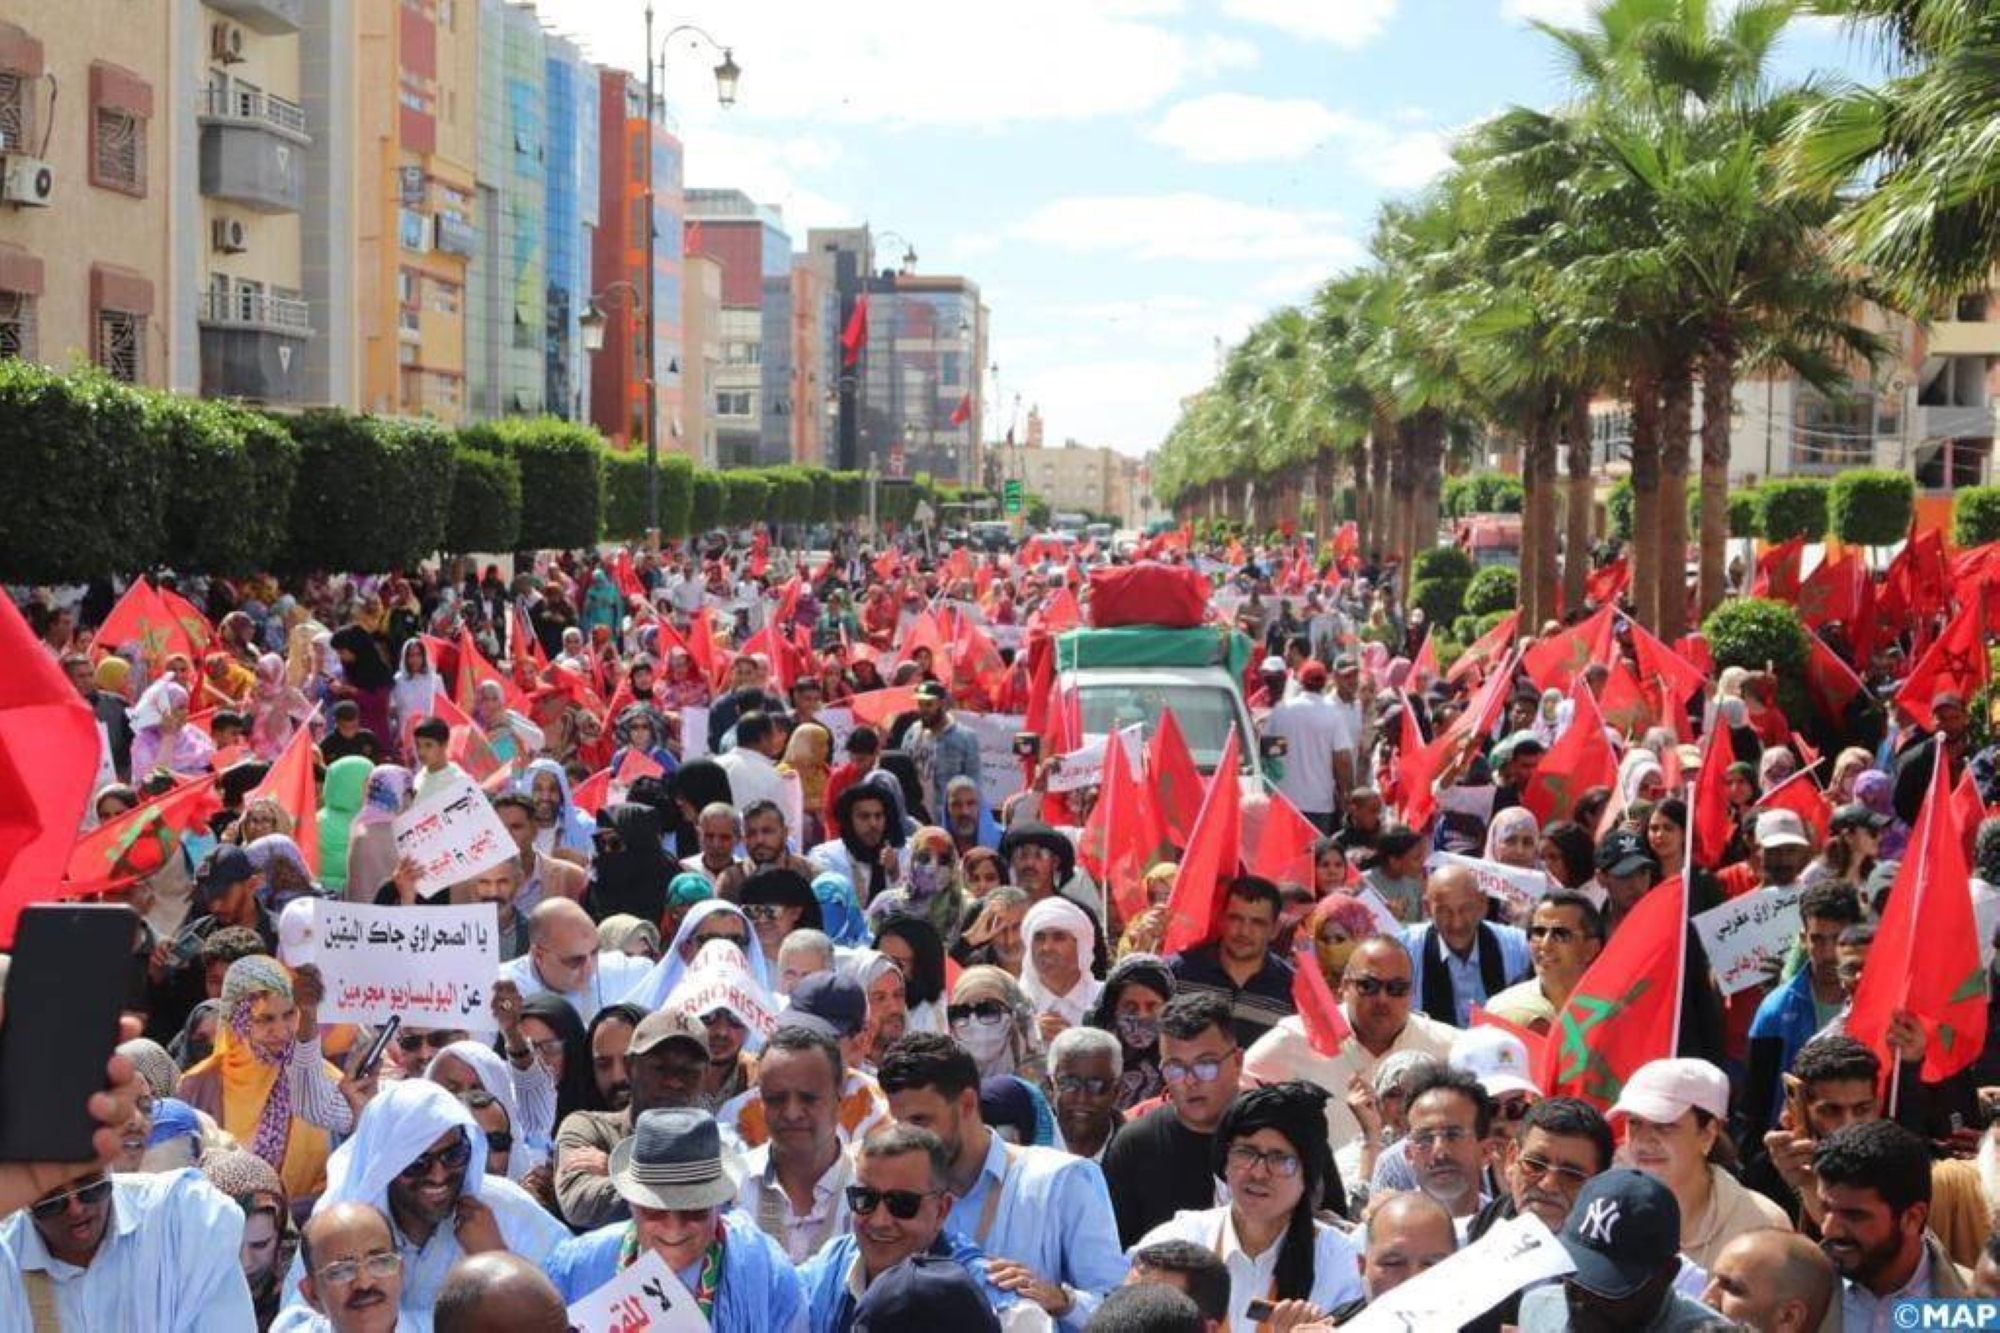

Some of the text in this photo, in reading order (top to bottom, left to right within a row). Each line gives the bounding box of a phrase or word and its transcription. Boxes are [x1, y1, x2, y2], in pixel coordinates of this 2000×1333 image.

[324, 916, 363, 949] اليقين
[367, 920, 405, 951] جاك
[409, 920, 471, 953] الصحراوي
[337, 979, 386, 1010] مجرمين
[390, 979, 458, 1012] البوليساريو
[1579, 1198, 1622, 1244] NY
